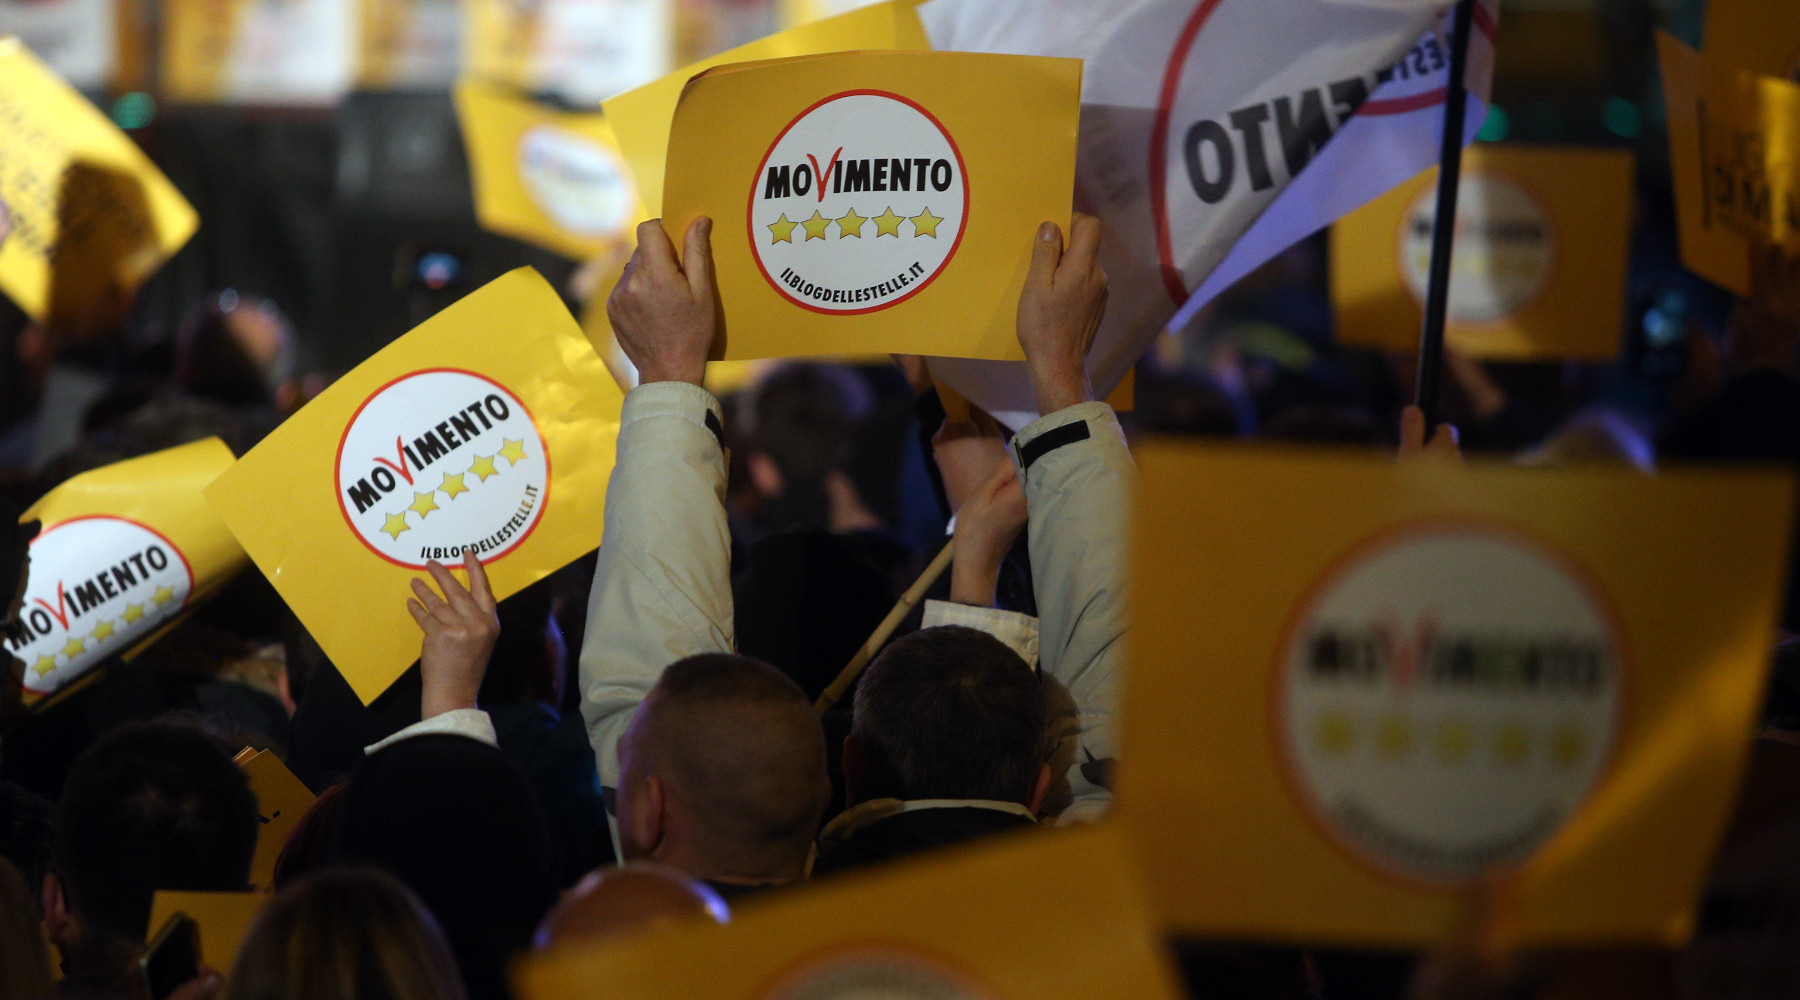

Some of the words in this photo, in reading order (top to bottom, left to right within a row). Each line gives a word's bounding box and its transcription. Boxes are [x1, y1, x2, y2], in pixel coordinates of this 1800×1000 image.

[764, 146, 953, 203] MOVIMENTO
[780, 261, 925, 303] ILBLOGDELLESTELLE.IT
[347, 394, 510, 515] MOVIMENTO
